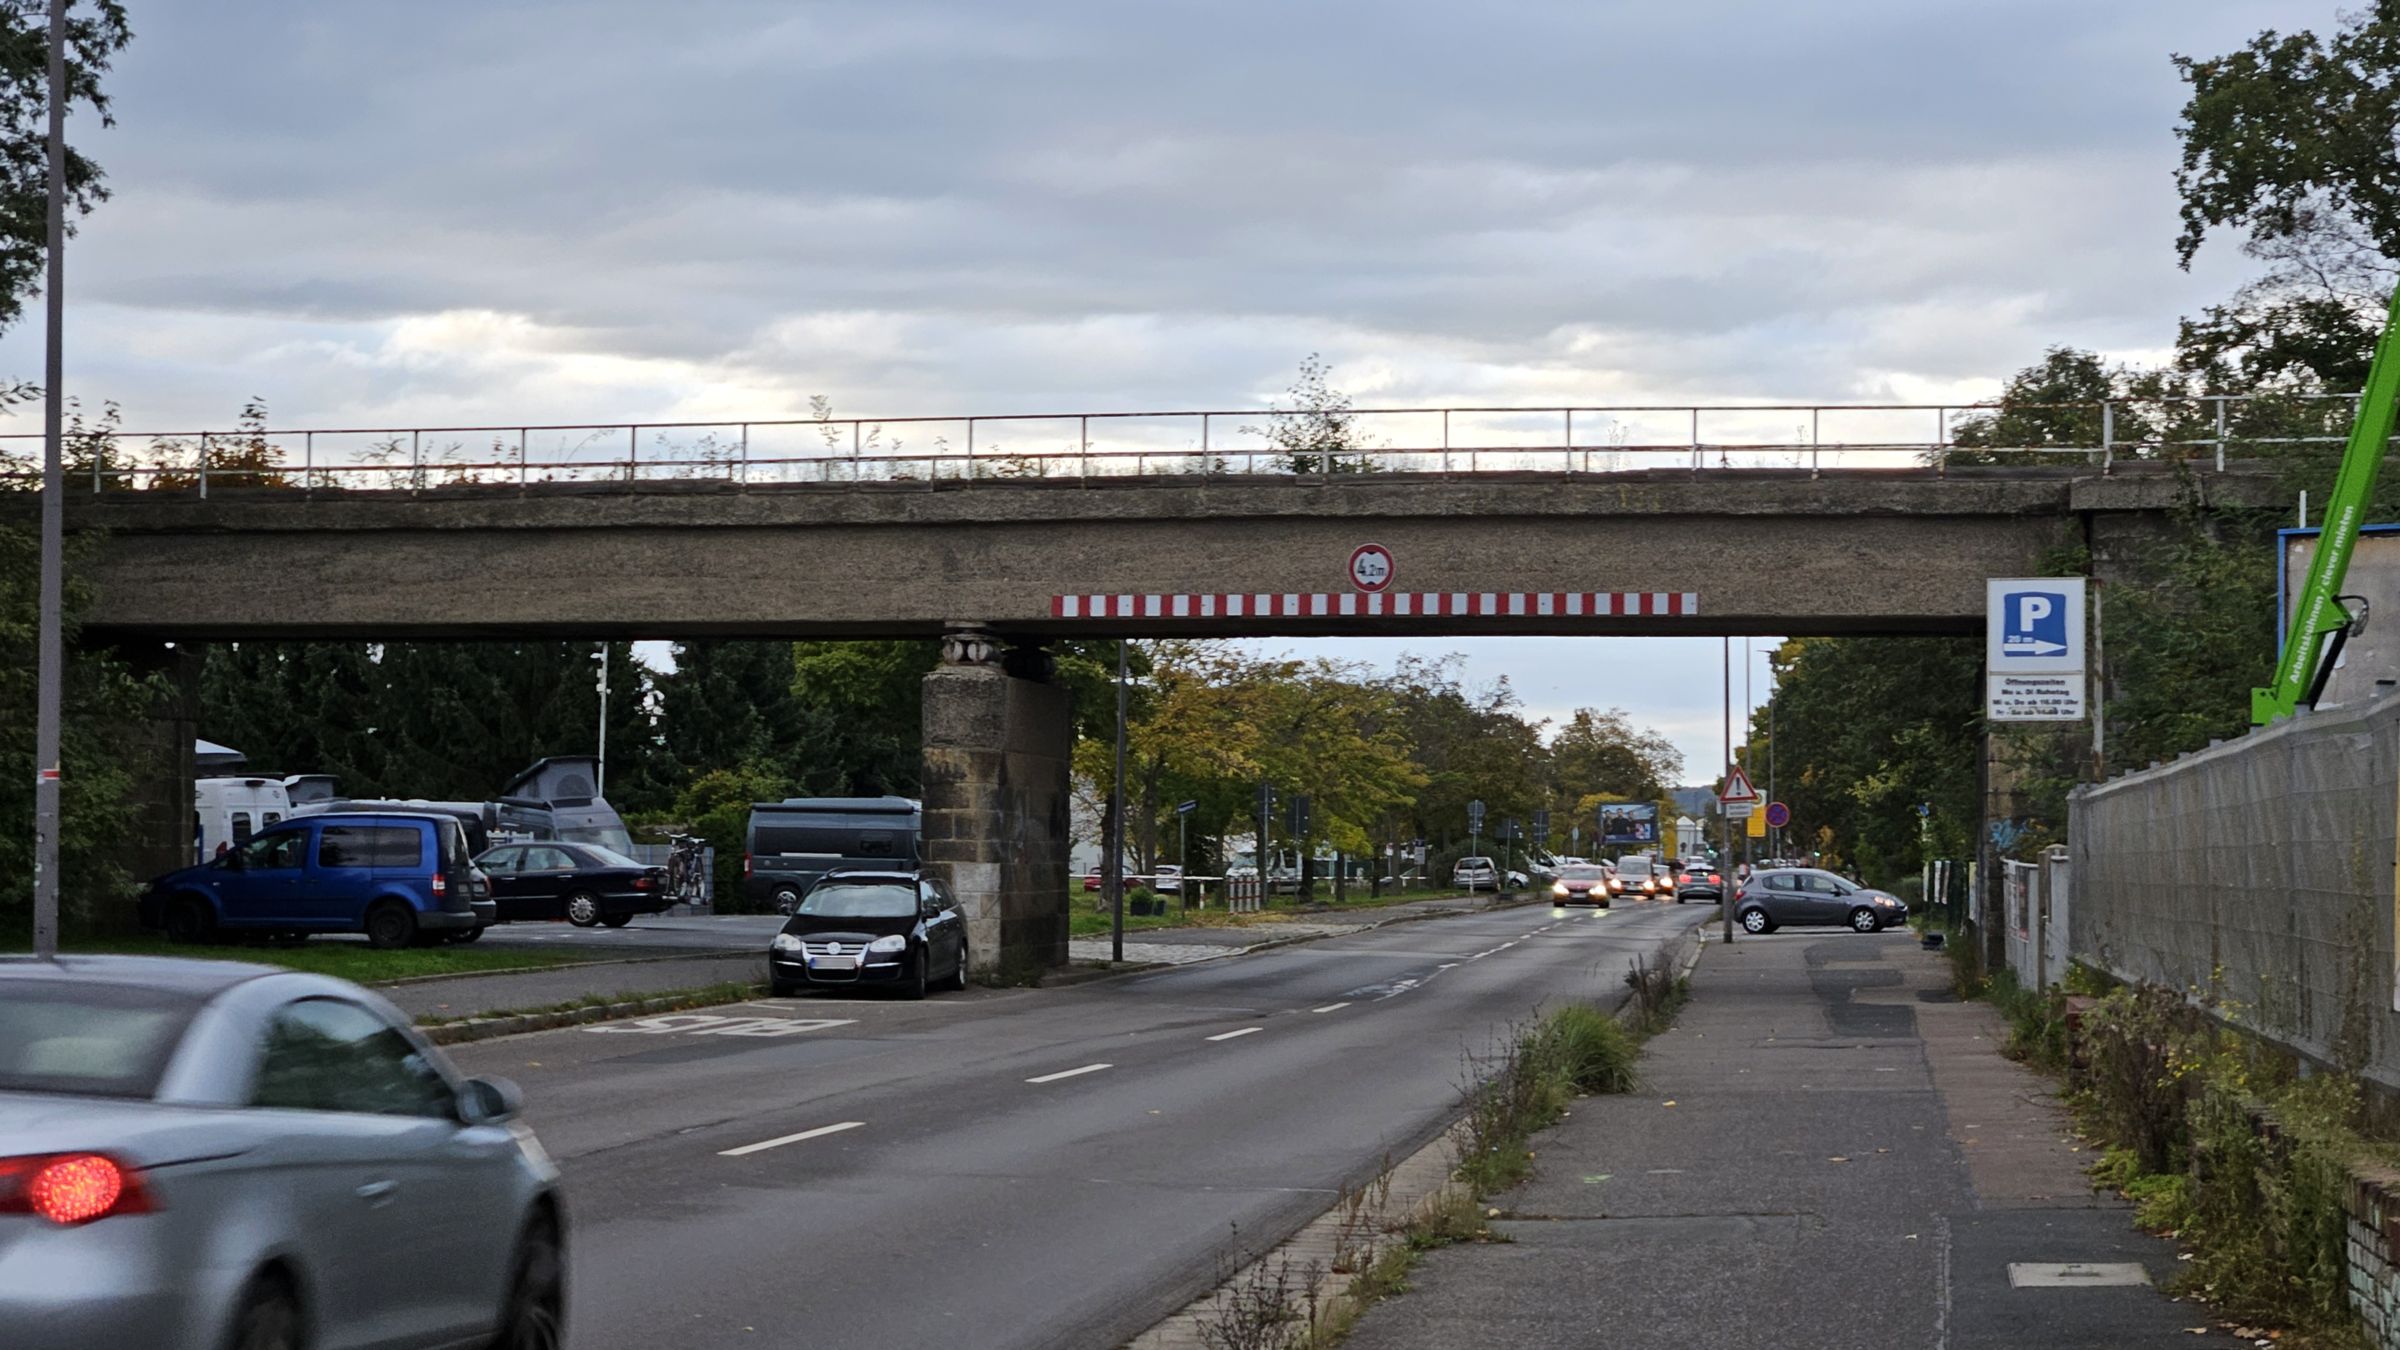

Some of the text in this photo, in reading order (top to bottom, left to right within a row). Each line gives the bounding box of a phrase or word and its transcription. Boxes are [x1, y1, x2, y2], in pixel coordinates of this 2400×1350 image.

[2320, 548, 2339, 586] clever
[2333, 505, 2354, 548] mieten
[2020, 596, 2052, 632] P
[2036, 688, 2070, 697] Ruhetag
[582, 1015, 860, 1037] BUS
